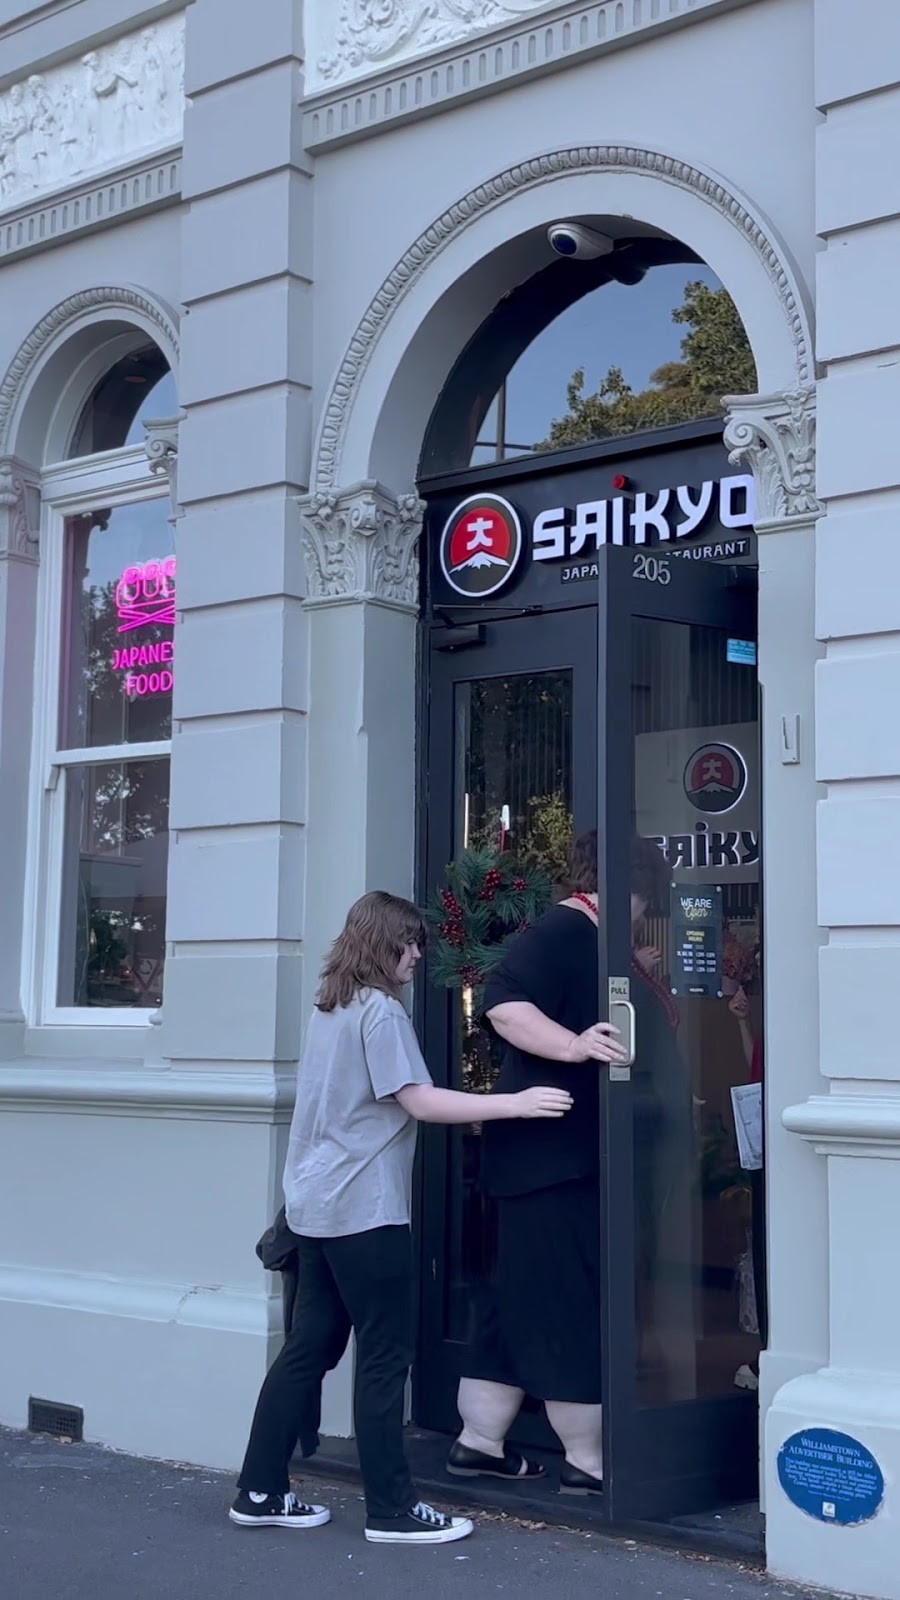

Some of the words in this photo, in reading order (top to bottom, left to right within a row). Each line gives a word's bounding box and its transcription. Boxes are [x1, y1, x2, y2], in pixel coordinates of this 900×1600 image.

[562, 564, 599, 581] JAPA
[632, 553, 671, 585] 205
[112, 641, 175, 670] JAPANE
[126, 671, 174, 696] FOOD
[680, 896, 694, 907] WE
[694, 898, 712, 909] ARE
[683, 906, 708, 921] Open
[611, 987, 628, 995] PULL
[801, 1437, 860, 1456] WILLIAMSTOWN
[789, 1445, 833, 1461] ADVERTISER
[837, 1453, 873, 1469] BUILDING
